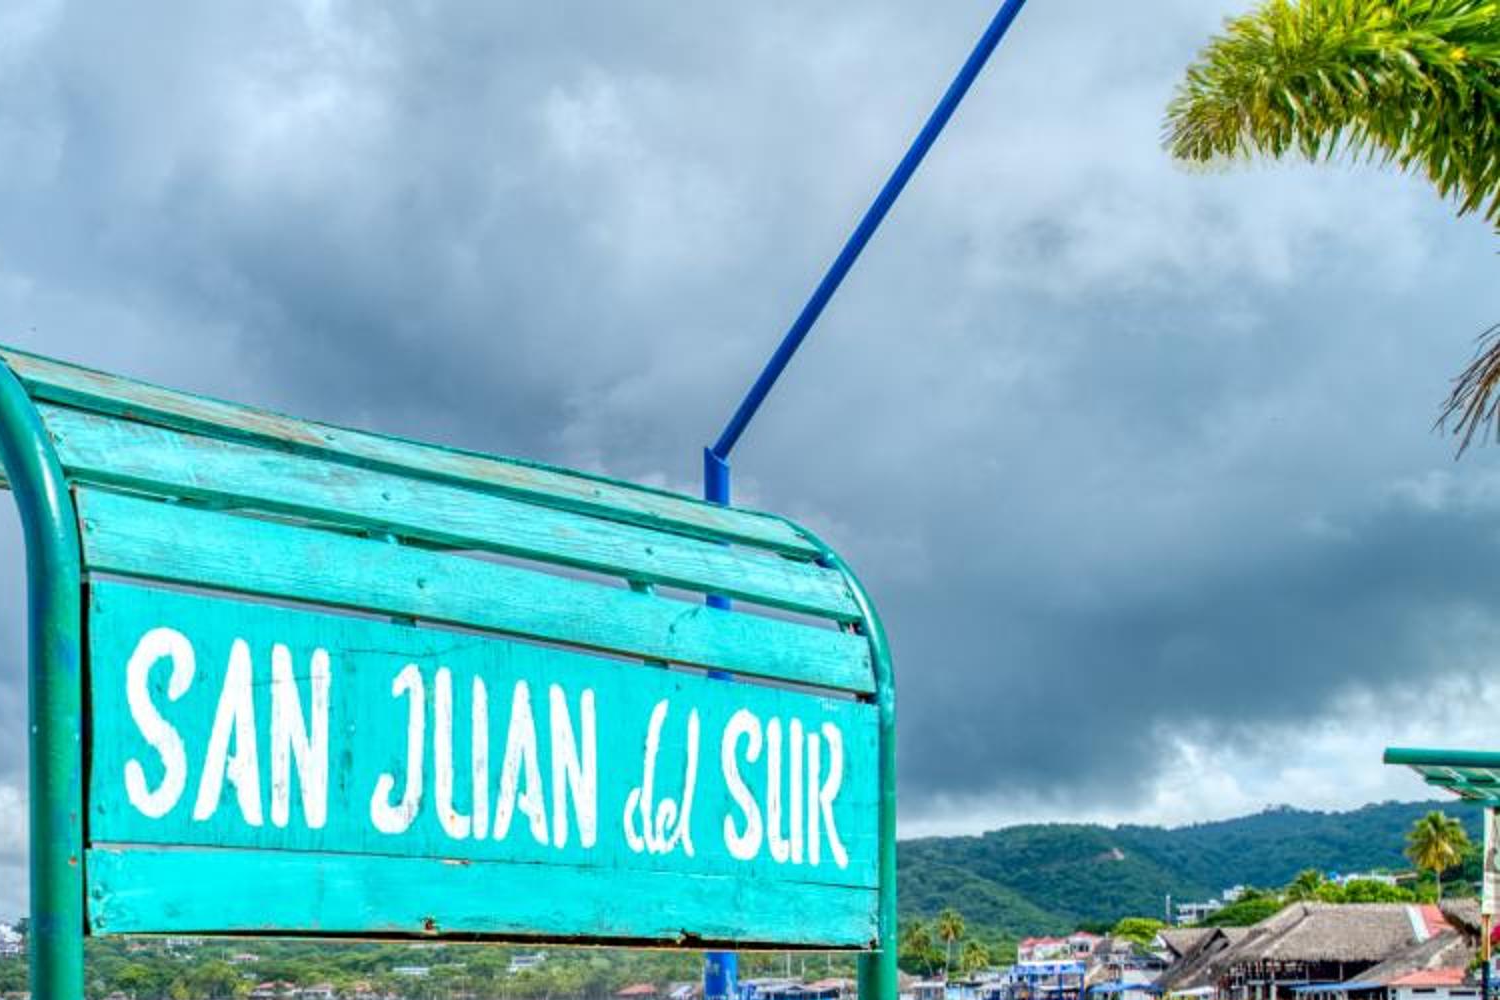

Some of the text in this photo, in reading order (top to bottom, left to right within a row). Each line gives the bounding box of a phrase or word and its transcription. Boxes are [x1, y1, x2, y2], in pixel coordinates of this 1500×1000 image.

[125, 627, 848, 868] SAN JUAN del SUR
